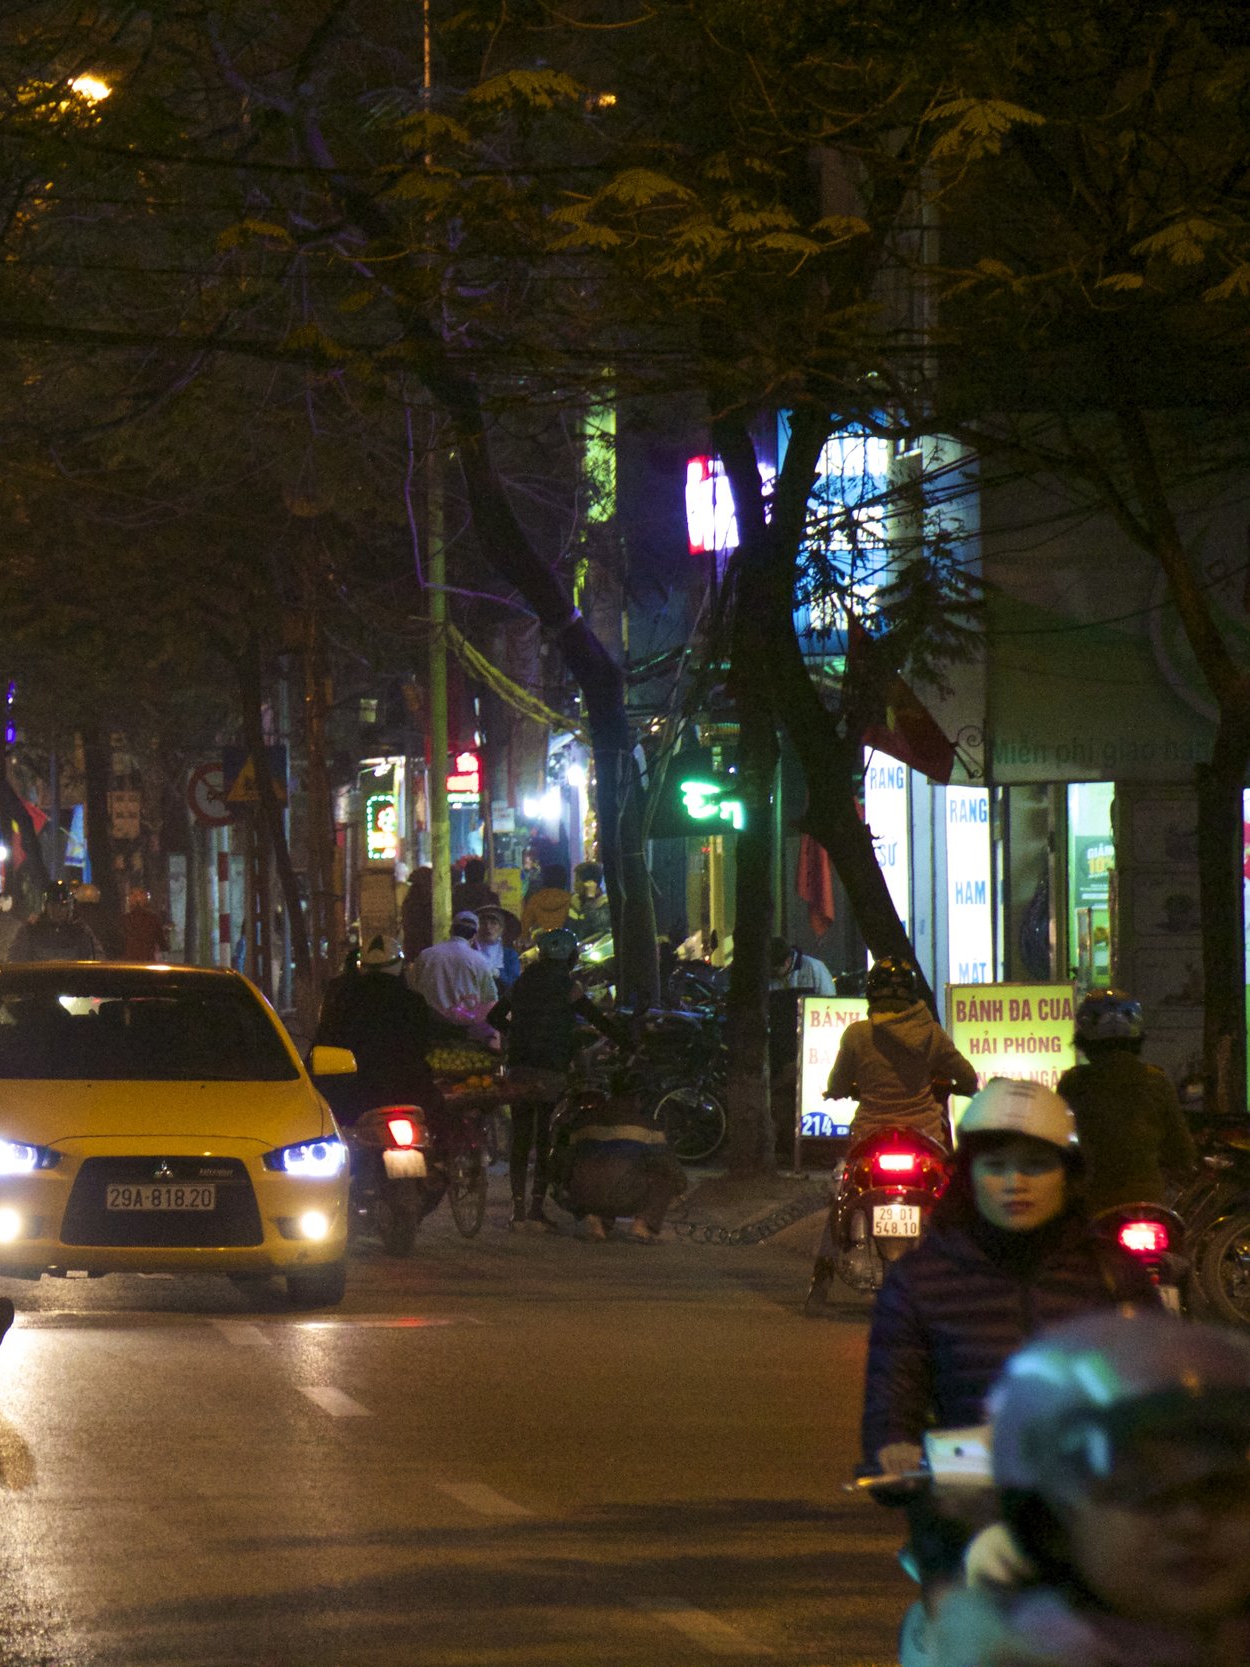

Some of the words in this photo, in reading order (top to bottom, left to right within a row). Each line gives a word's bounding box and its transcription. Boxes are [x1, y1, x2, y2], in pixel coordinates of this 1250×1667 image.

[956, 995, 1003, 1022] BÁNH
[1009, 998, 1033, 1021] ĐA
[1038, 998, 1074, 1021] CUA
[970, 1031, 997, 1054] HẢI
[1004, 1033, 1061, 1053] PHÒNG
[801, 1115, 832, 1136] 214
[110, 1188, 212, 1208] 29A-818.20
[876, 1222, 916, 1234] 548.10
